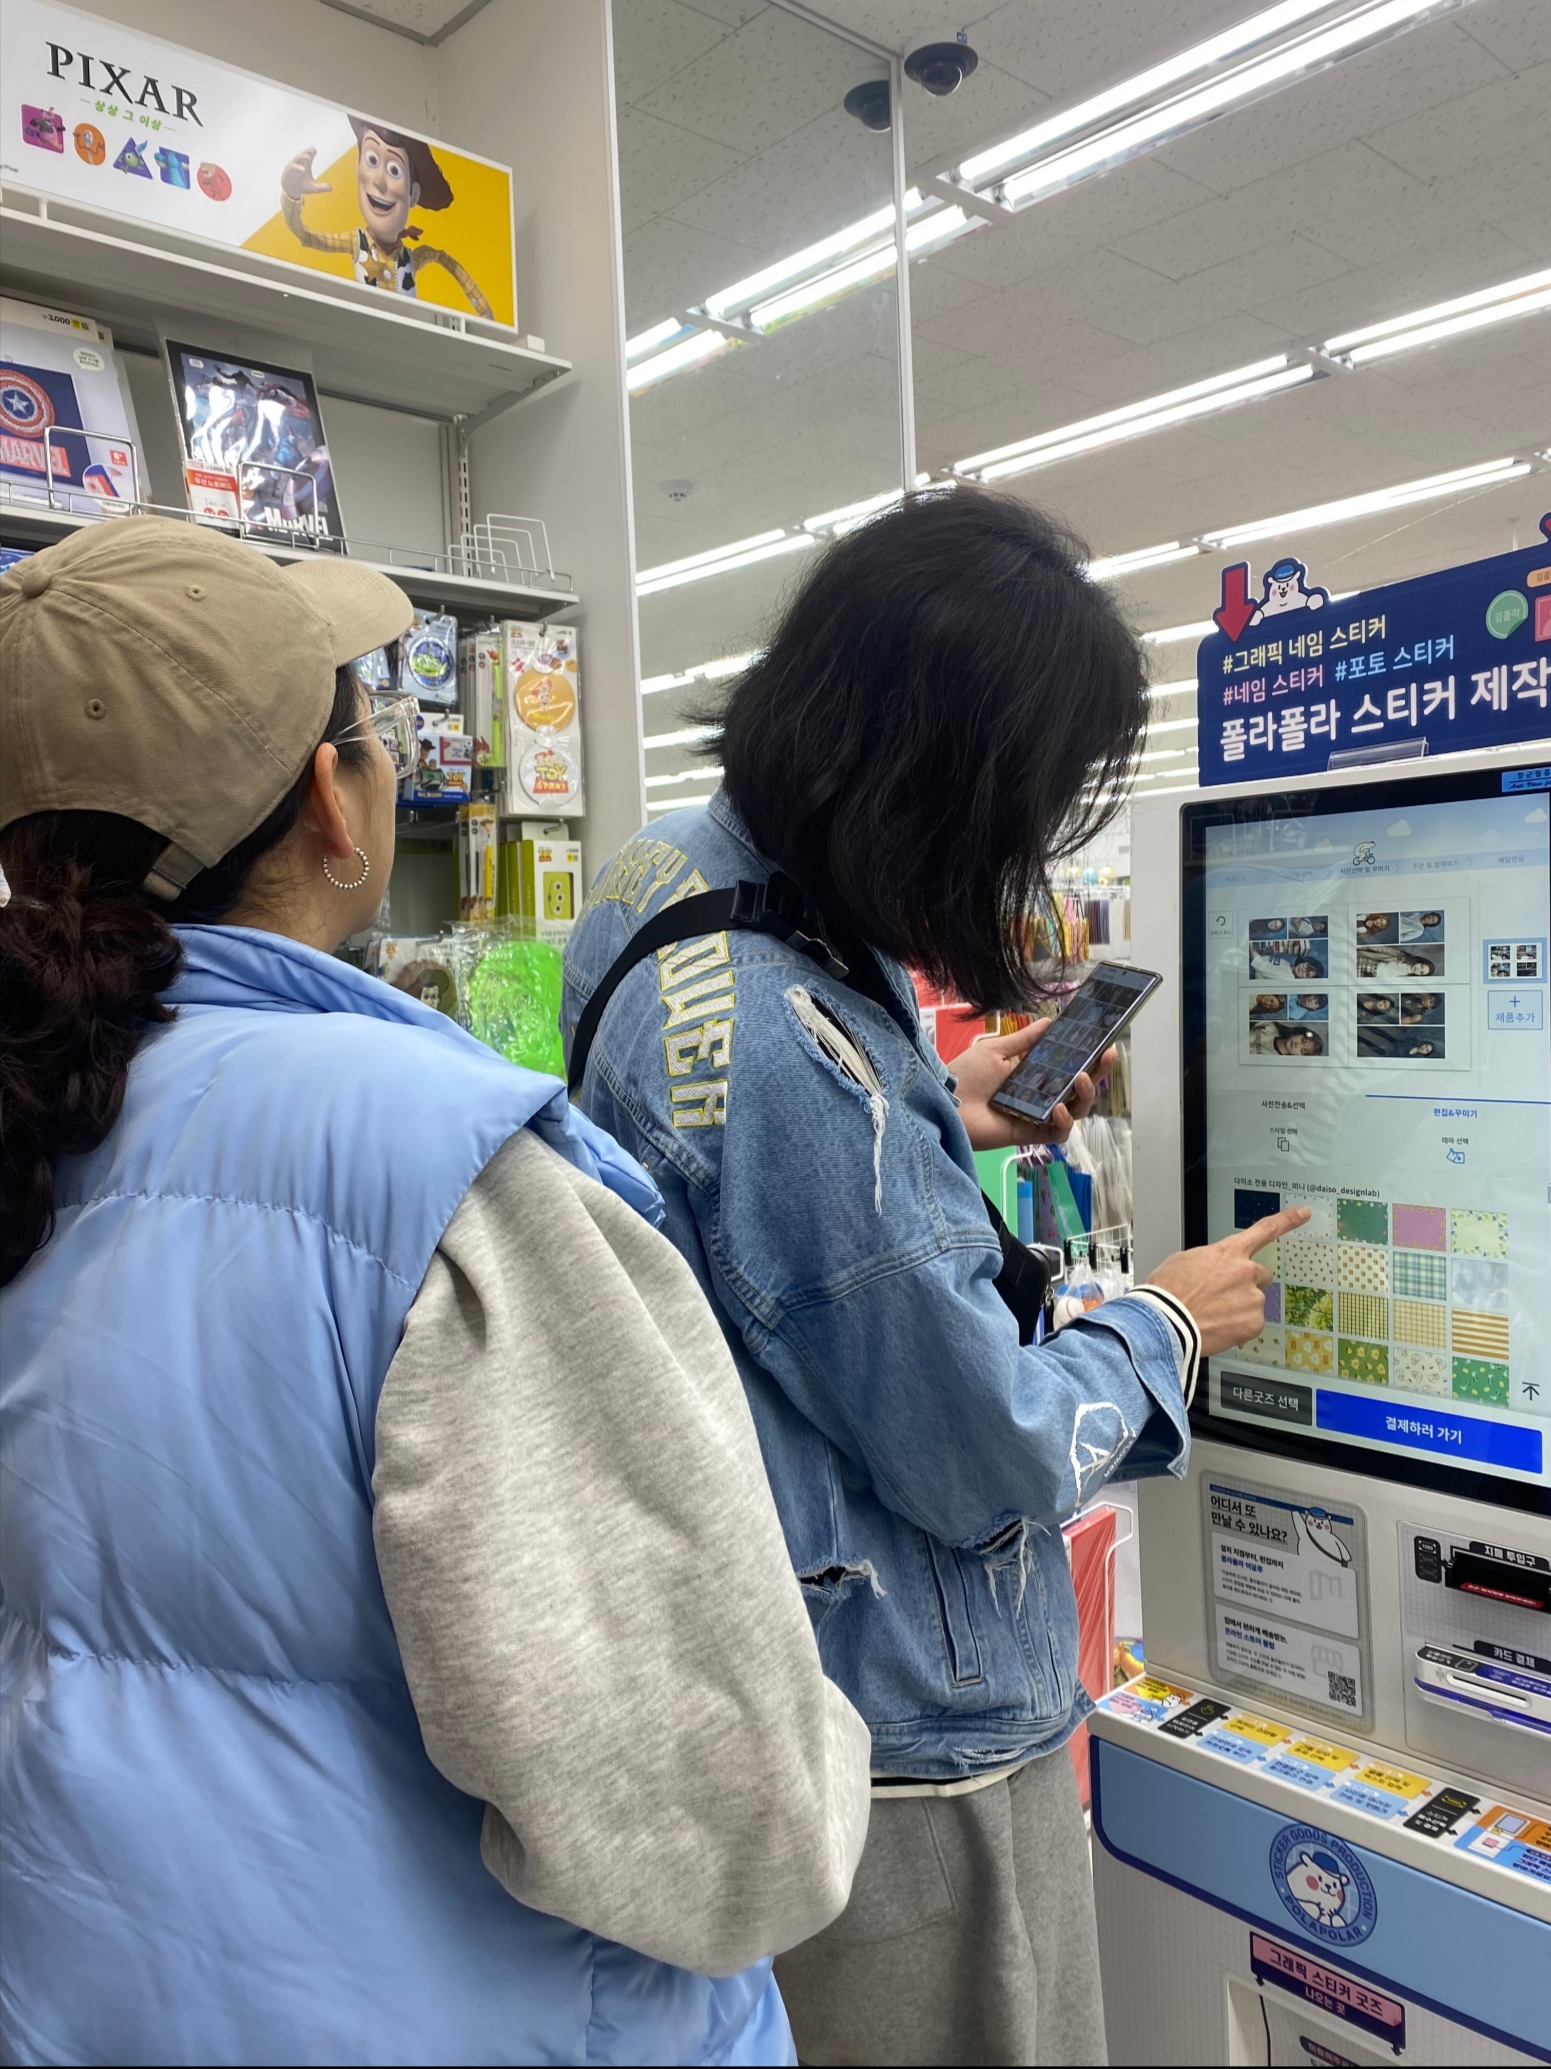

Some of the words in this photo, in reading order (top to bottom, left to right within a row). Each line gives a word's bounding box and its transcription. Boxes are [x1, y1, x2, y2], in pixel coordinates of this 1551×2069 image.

[46, 41, 203, 127] PIXAR
[95, 100, 119, 117] 상상
[123, 110, 134, 121] 그
[139, 116, 162, 131] 이상
[1222, 641, 1283, 674] #그래픽
[1288, 630, 1323, 658] 네임
[1330, 614, 1386, 649] 스티커
[1223, 677, 1266, 706] #네임
[1272, 664, 1323, 696] 스티커
[1335, 651, 1387, 682] #포토
[1393, 634, 1454, 670] 스티커
[1220, 699, 1341, 762] 폴라폴라
[1351, 675, 1455, 733] 스티커
[1470, 656, 1551, 711] 제작
[534, 766, 568, 781] TOY
[1495, 1012, 1535, 1023] 제품추가
[1261, 1100, 1306, 1110] 사진전송&선택
[1433, 1108, 1478, 1118] 편집&꾸미기
[1269, 1126, 1285, 1134] 스타일
[1287, 1127, 1298, 1135] 선택
[1234, 1177, 1253, 1186] 다이소
[1254, 1179, 1267, 1187] 전용
[1268, 1180, 1305, 1191] 디자인_미니
[1306, 1184, 1380, 1198] (@daiso_designlab)
[1232, 1387, 1275, 1406] 다른굿즈
[1277, 1396, 1299, 1412] 선택
[1385, 1416, 1434, 1439] 결제하러
[1437, 1426, 1462, 1445] 가기
[1210, 1496, 1242, 1515] 어디서
[1245, 1505, 1256, 1518] 또
[1211, 1512, 1232, 1529] 만날
[1235, 1520, 1246, 1532] 수
[1249, 1522, 1288, 1543] 있나요?
[1484, 1546, 1503, 1560] 지폐
[1506, 1550, 1536, 1567] 투입구
[1493, 1647, 1513, 1662] 카드
[1515, 1653, 1535, 1668] 결제
[1274, 1834, 1291, 1880] STICKER
[1290, 1828, 1328, 1844] GOODS
[1330, 1839, 1373, 1920] PRODUCTION
[1283, 1895, 1363, 1941] POLAPOLAR
[1270, 1948, 1307, 1980] 그래픽
[1312, 1971, 1350, 2001] 스티커
[1356, 1990, 1383, 2017] 굿즈
[1305, 1986, 1333, 2011] 나오는
[1336, 2001, 1346, 2016] 곳
